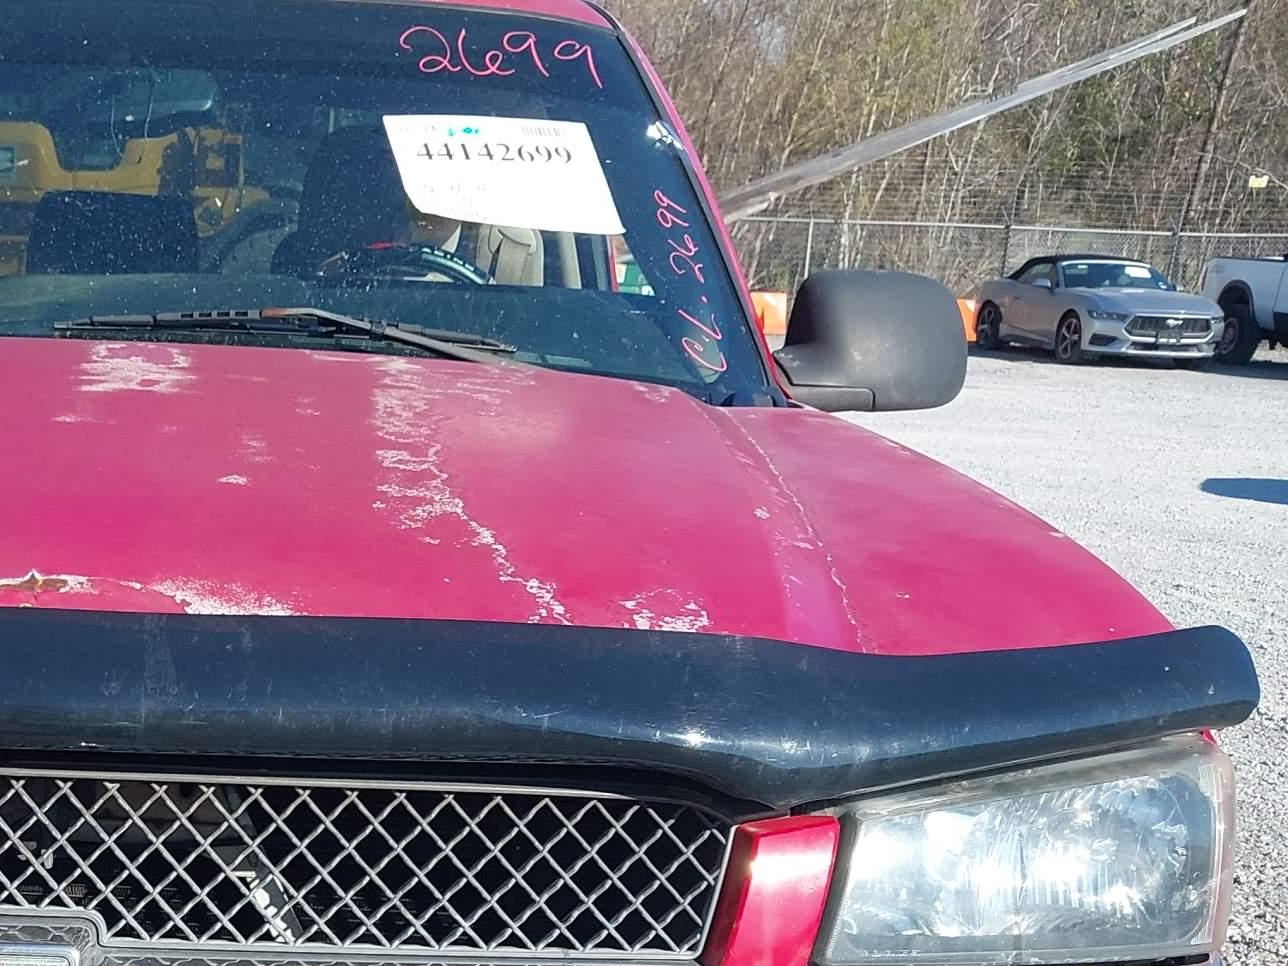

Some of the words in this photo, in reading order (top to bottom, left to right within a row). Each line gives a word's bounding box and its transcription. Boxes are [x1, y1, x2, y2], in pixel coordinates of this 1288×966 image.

[400, 26, 602, 89] 2699
[416, 143, 572, 164] 44142699
[654, 189, 705, 284] 2699
